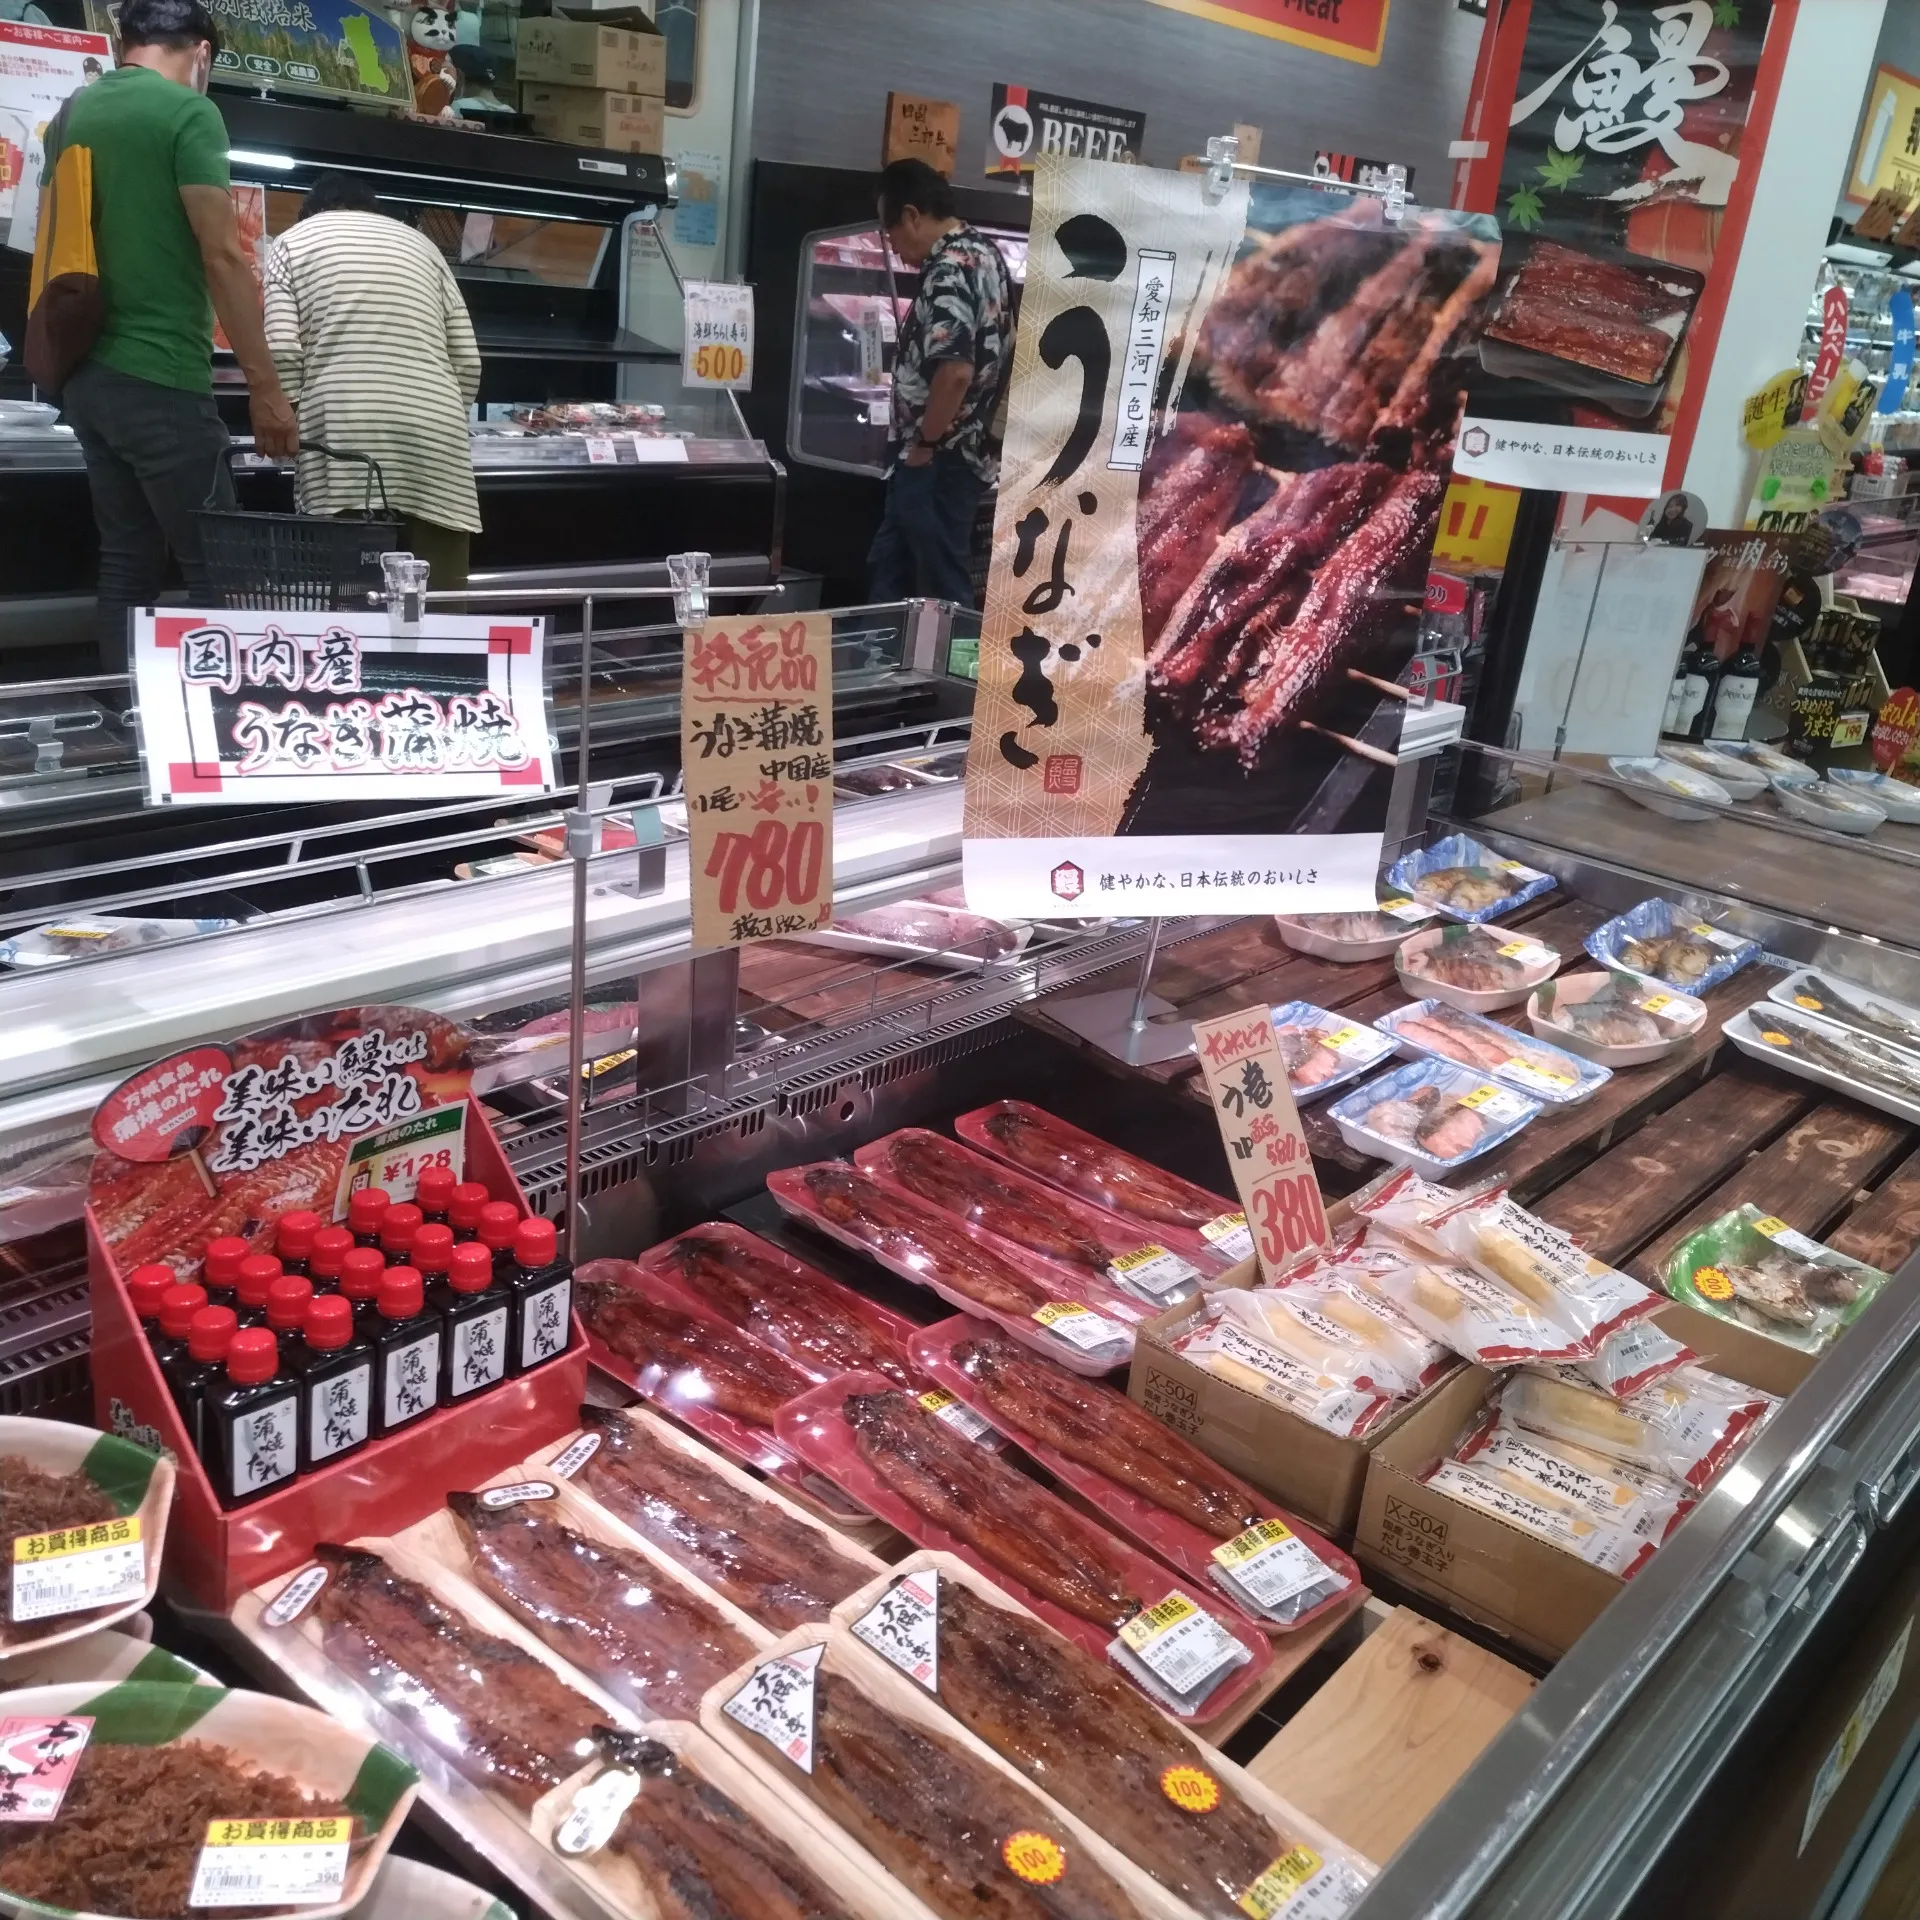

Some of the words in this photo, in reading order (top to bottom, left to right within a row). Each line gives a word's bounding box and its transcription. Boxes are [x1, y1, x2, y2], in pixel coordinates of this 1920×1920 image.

[696, 346, 743, 379] 500
[1119, 277, 1165, 448] 愛知三河一色産
[1495, 438, 1657, 464] 健やかな、日本伝統のおいしさ
[1000, 214, 1128, 769] うなぎ
[182, 628, 361, 692] 国内産
[691, 621, 818, 692] 特売品
[236, 694, 527, 770] うなぎ蒲焼
[690, 701, 824, 759] うなぎ蒲焼
[759, 752, 832, 782] 中国産
[704, 819, 824, 914] 780
[1099, 869, 1320, 892] 健やかな、日本伝統のおいしさ
[1769, 956, 1790, 969] LINE
[112, 1070, 223, 1144] 蒲焼のたれ
[383, 1148, 452, 1183] ¥128
[1252, 1173, 1326, 1266] 380
[1148, 1369, 1196, 1407] X-504
[324, 1378, 359, 1448] 蒲焼のたれ
[1143, 1400, 1200, 1436] だし巻玉子
[247, 1411, 286, 1483] 蒲焼のたれ
[27, 1520, 130, 1556] お買得商品
[1387, 1499, 1444, 1540] X-504
[1221, 1520, 1285, 1561] お買得商品
[1381, 1531, 1449, 1572] だし巻玉子
[119, 1570, 141, 1582] 398
[1128, 1598, 1188, 1641] お買得商品
[221, 1819, 339, 1841] お買得商品
[316, 1872, 340, 1884] 398
